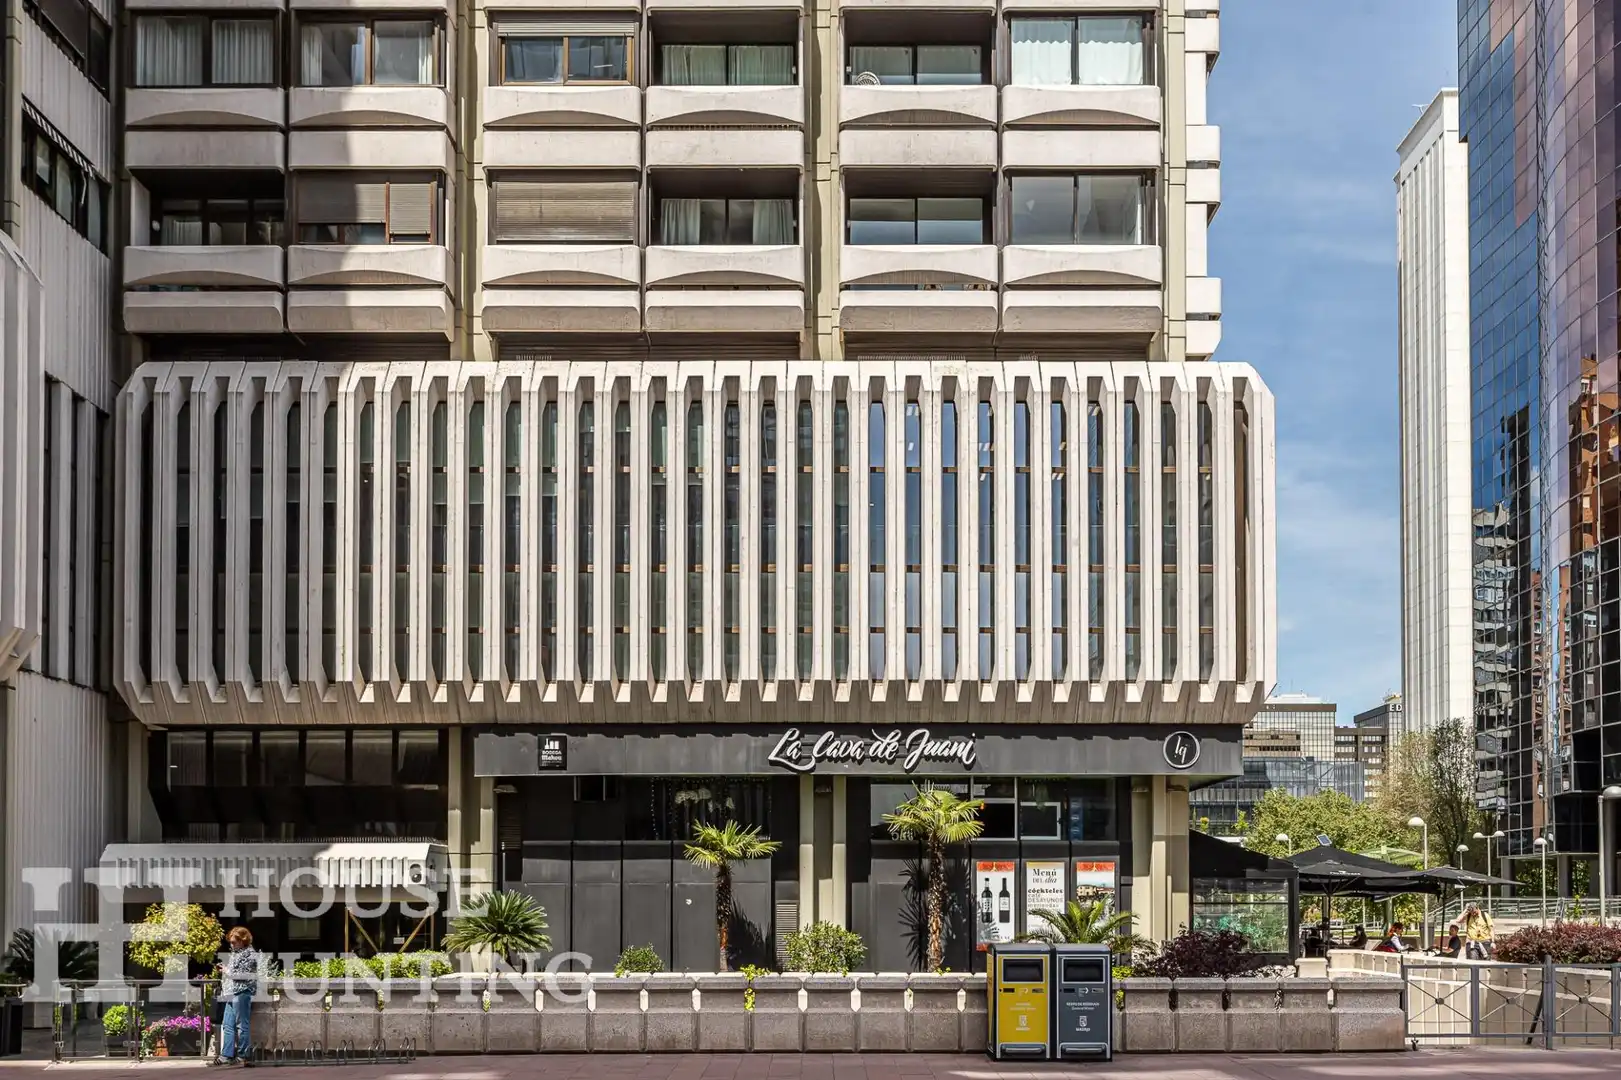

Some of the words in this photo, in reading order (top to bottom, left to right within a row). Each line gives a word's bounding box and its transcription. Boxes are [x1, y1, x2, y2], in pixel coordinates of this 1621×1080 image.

[767, 727, 816, 771] La
[812, 730, 866, 760] Cava
[869, 728, 902, 760] de
[903, 728, 977, 770] Juani
[1032, 868, 1057, 877] Menú
